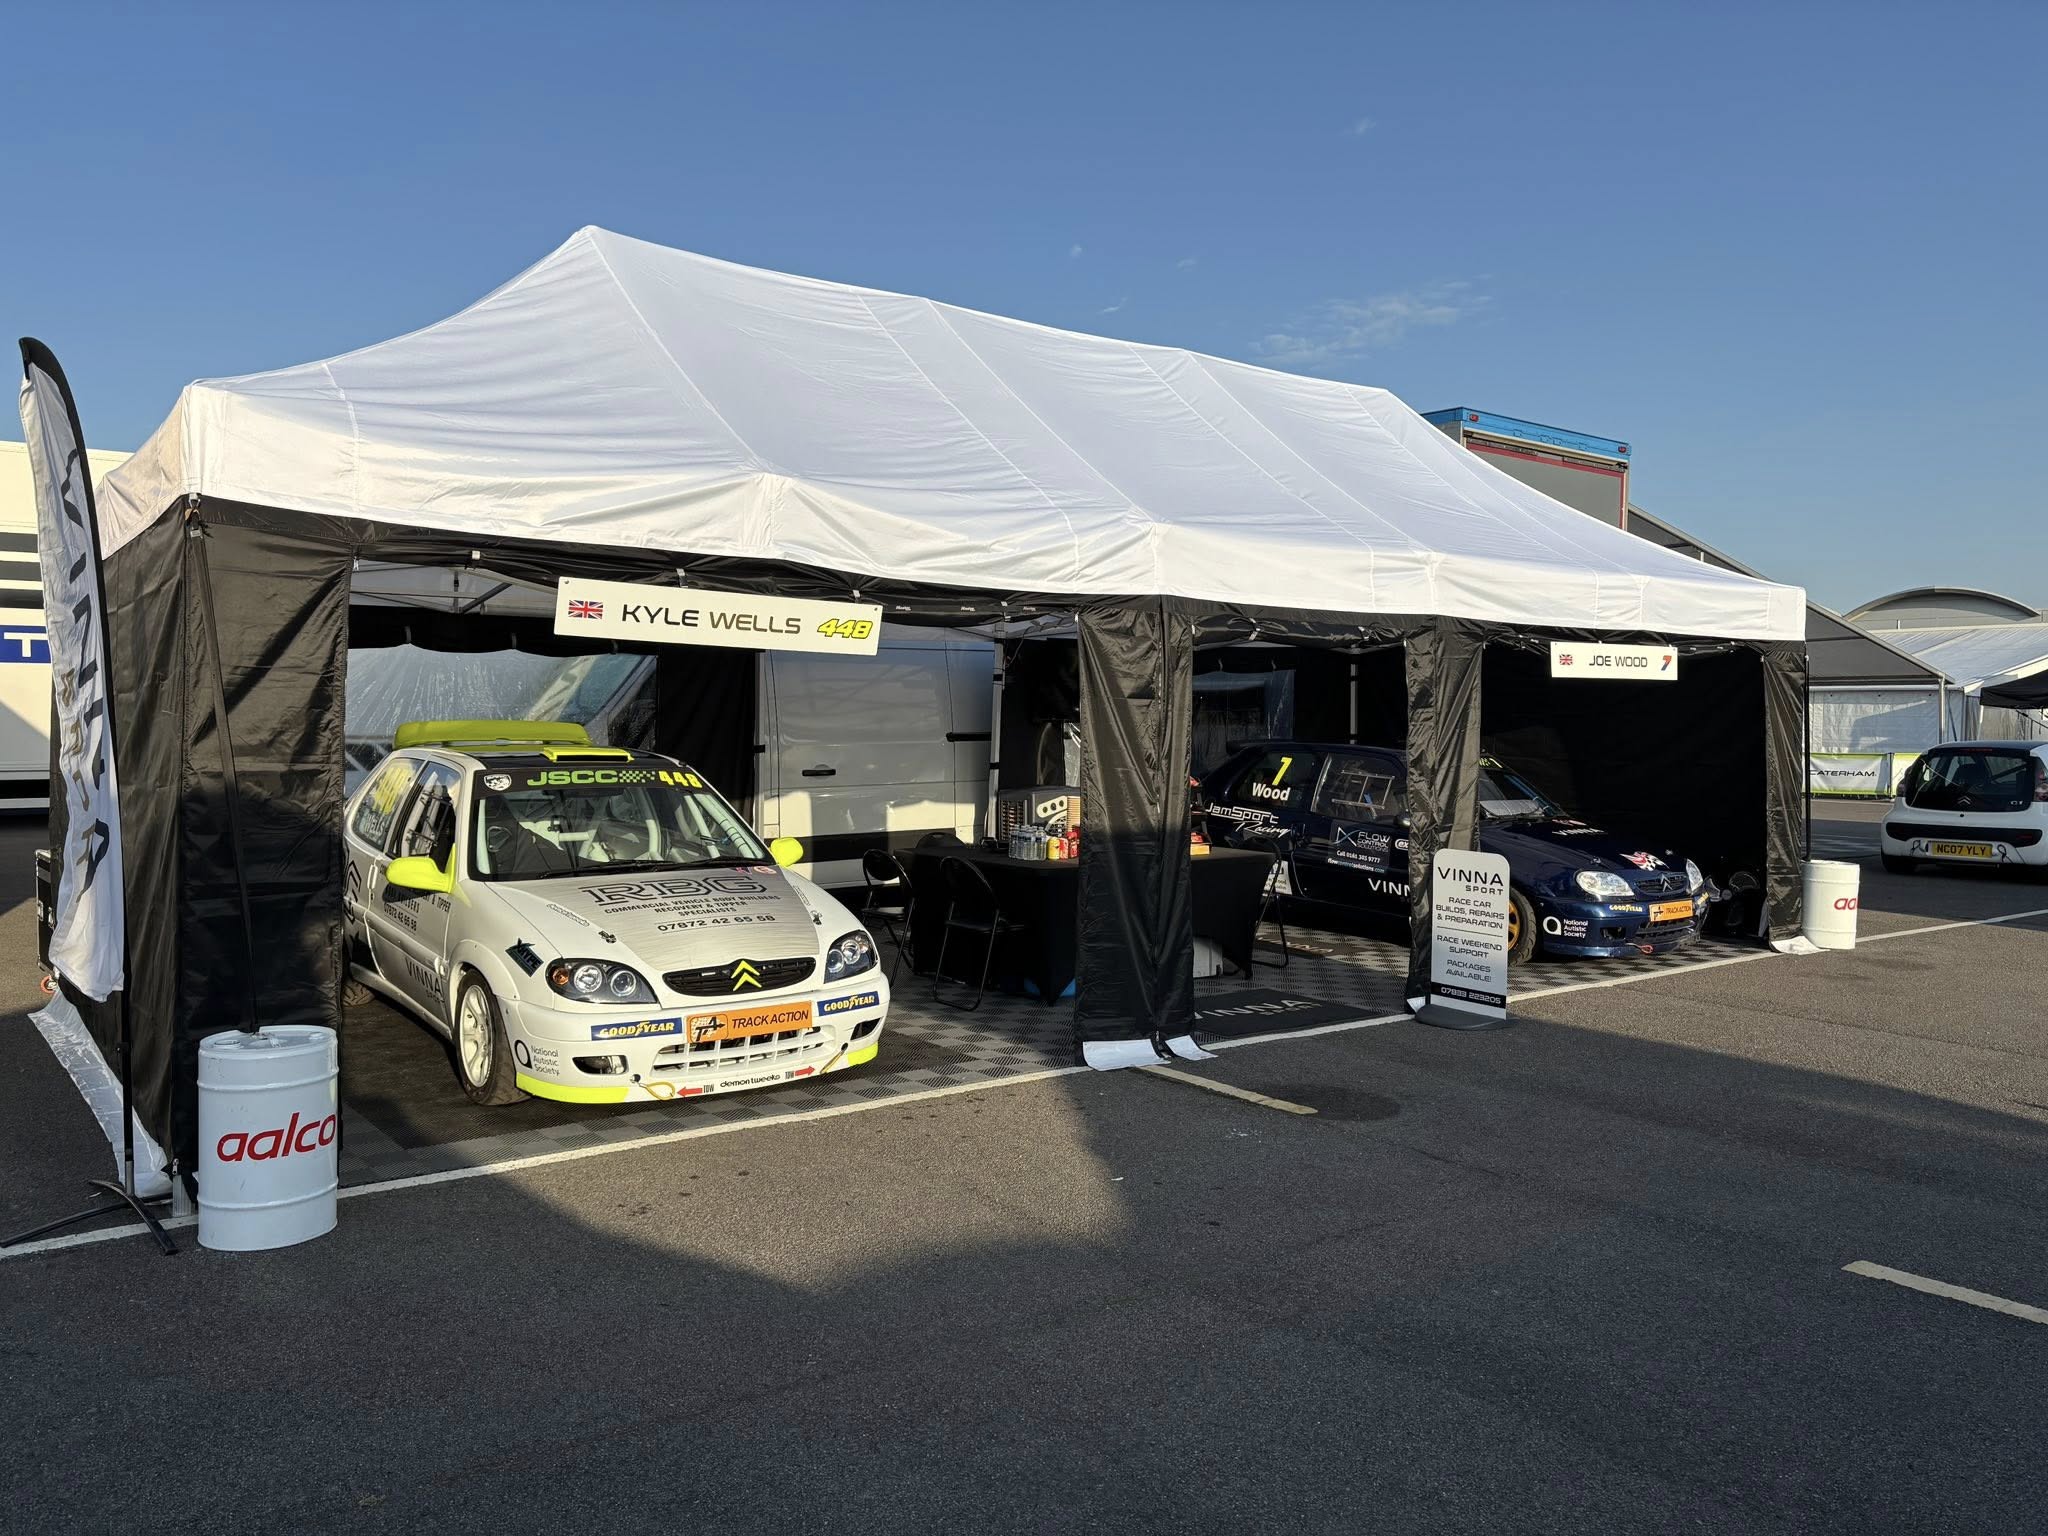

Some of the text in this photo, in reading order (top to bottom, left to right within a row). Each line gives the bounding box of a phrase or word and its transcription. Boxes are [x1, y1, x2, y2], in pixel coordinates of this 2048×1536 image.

[621, 603, 874, 639] KYLE WELLS 448
[1589, 655, 1673, 671] JOE WOOD 7
[527, 770, 703, 789] JSCC 448
[1810, 769, 1875, 777] CATERHAM
[1252, 782, 1291, 801] Wood
[1233, 820, 1291, 838] Racing
[1357, 839, 1389, 849] CONTROL
[1358, 831, 1390, 843] FLOW
[1936, 844, 1987, 856] NC07 YLY
[1437, 866, 1504, 887] VINNA
[578, 876, 768, 907] RBG
[1368, 878, 1411, 897] VINN
[1465, 885, 1504, 895] SPORT
[604, 902, 670, 914] COMMERCIAL
[671, 897, 711, 906] VEHICLE
[654, 904, 703, 913] RECOVERY
[1448, 897, 1492, 909] RACE CAR
[678, 907, 737, 916] SPECIALISTS
[1435, 904, 1505, 920] BUILDS, REPAIRS
[657, 919, 708, 931] 07872
[1445, 914, 1503, 929] PREPARATION
[1563, 918, 1588, 926] National
[1437, 935, 1503, 951] RACE WEEKEND
[1449, 946, 1489, 958] SUPPORT
[1447, 959, 1491, 973] PACKAGES
[405, 957, 445, 995] VINNA
[824, 995, 875, 1012] GOODYEAR
[731, 1016, 769, 1029] TRACK
[769, 1010, 809, 1024] ACTION
[600, 1020, 675, 1037] GOODYEAR
[530, 1045, 559, 1057] National
[533, 1055, 560, 1067] Autistic
[534, 1063, 561, 1076] Society
[784, 1071, 795, 1080] TOW
[703, 1084, 715, 1093] TOW
[216, 1112, 337, 1162] aalco
